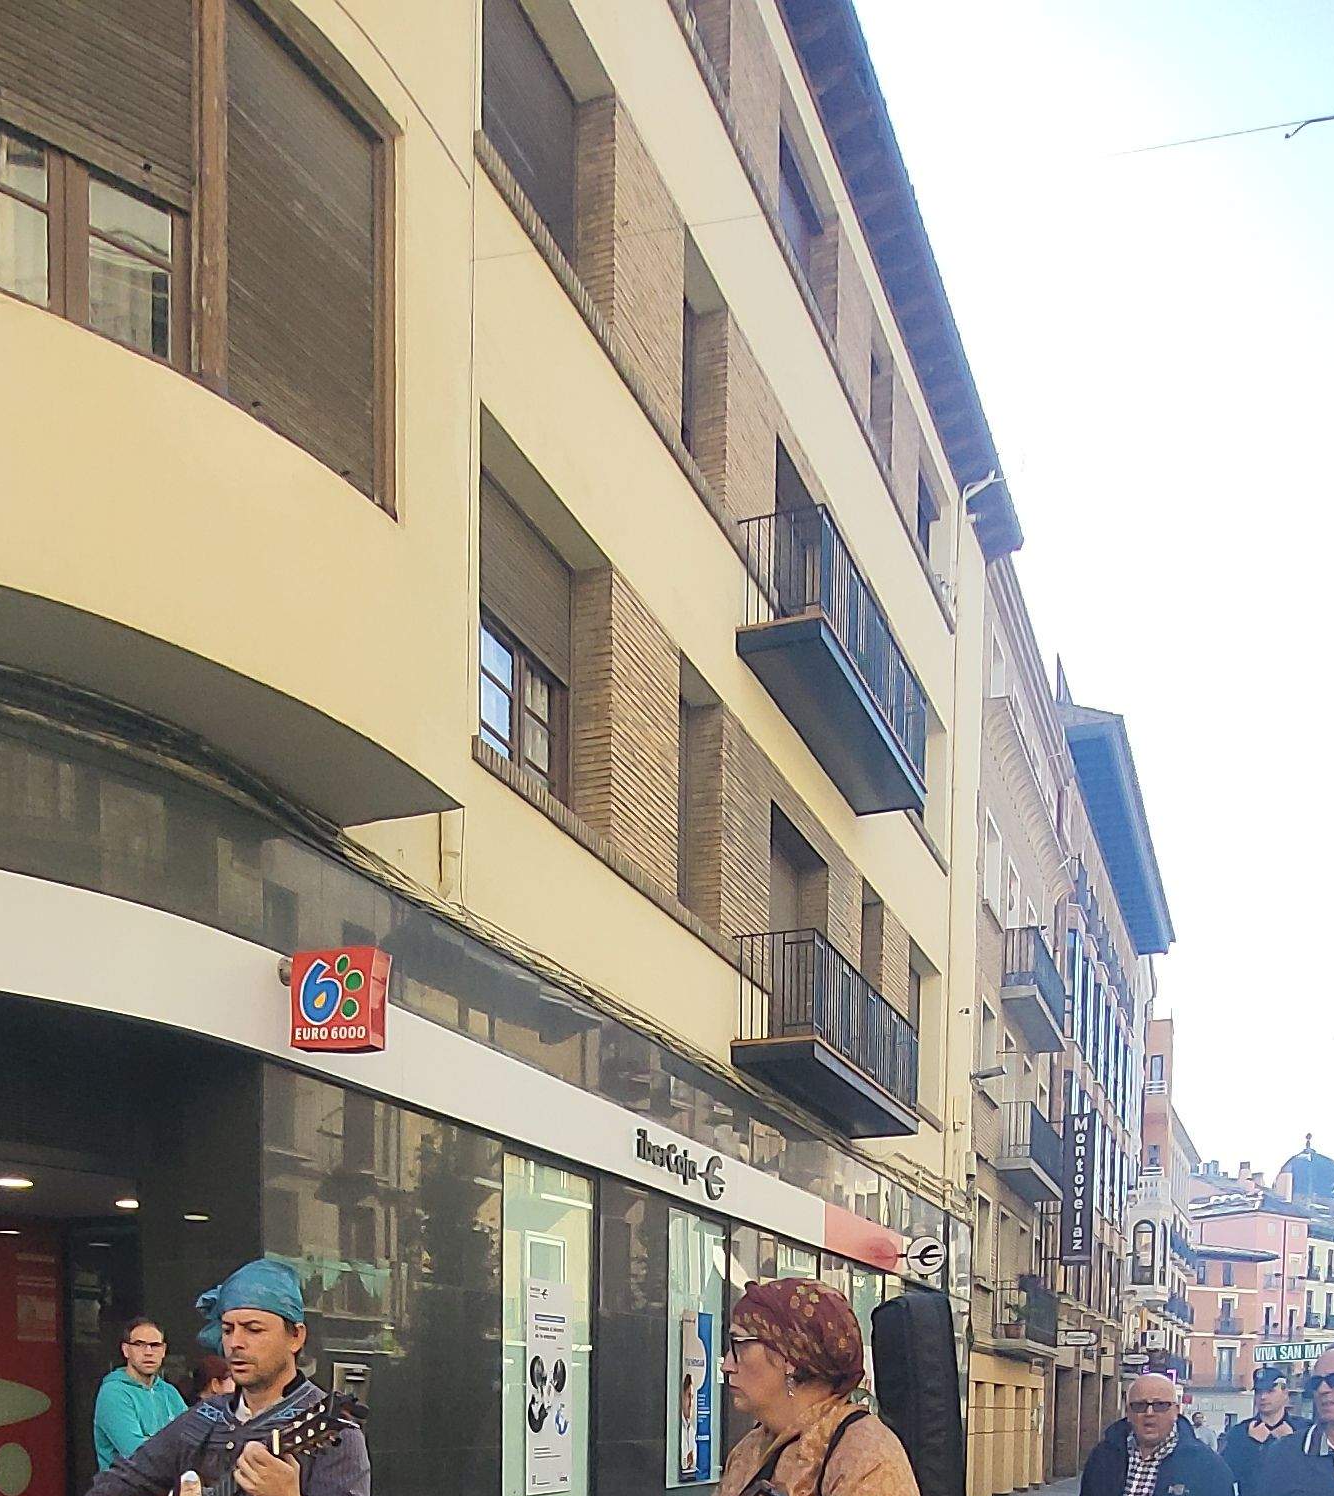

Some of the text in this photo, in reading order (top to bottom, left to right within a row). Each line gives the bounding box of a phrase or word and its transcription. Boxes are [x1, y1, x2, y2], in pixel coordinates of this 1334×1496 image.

[294, 1026, 366, 1040] EURO 6000
[636, 1128, 697, 1186] iberCaja
[1072, 1116, 1088, 1250] Montovelaz
[1255, 1346, 1277, 1361] VIVA
[1279, 1345, 1302, 1360] SAN
